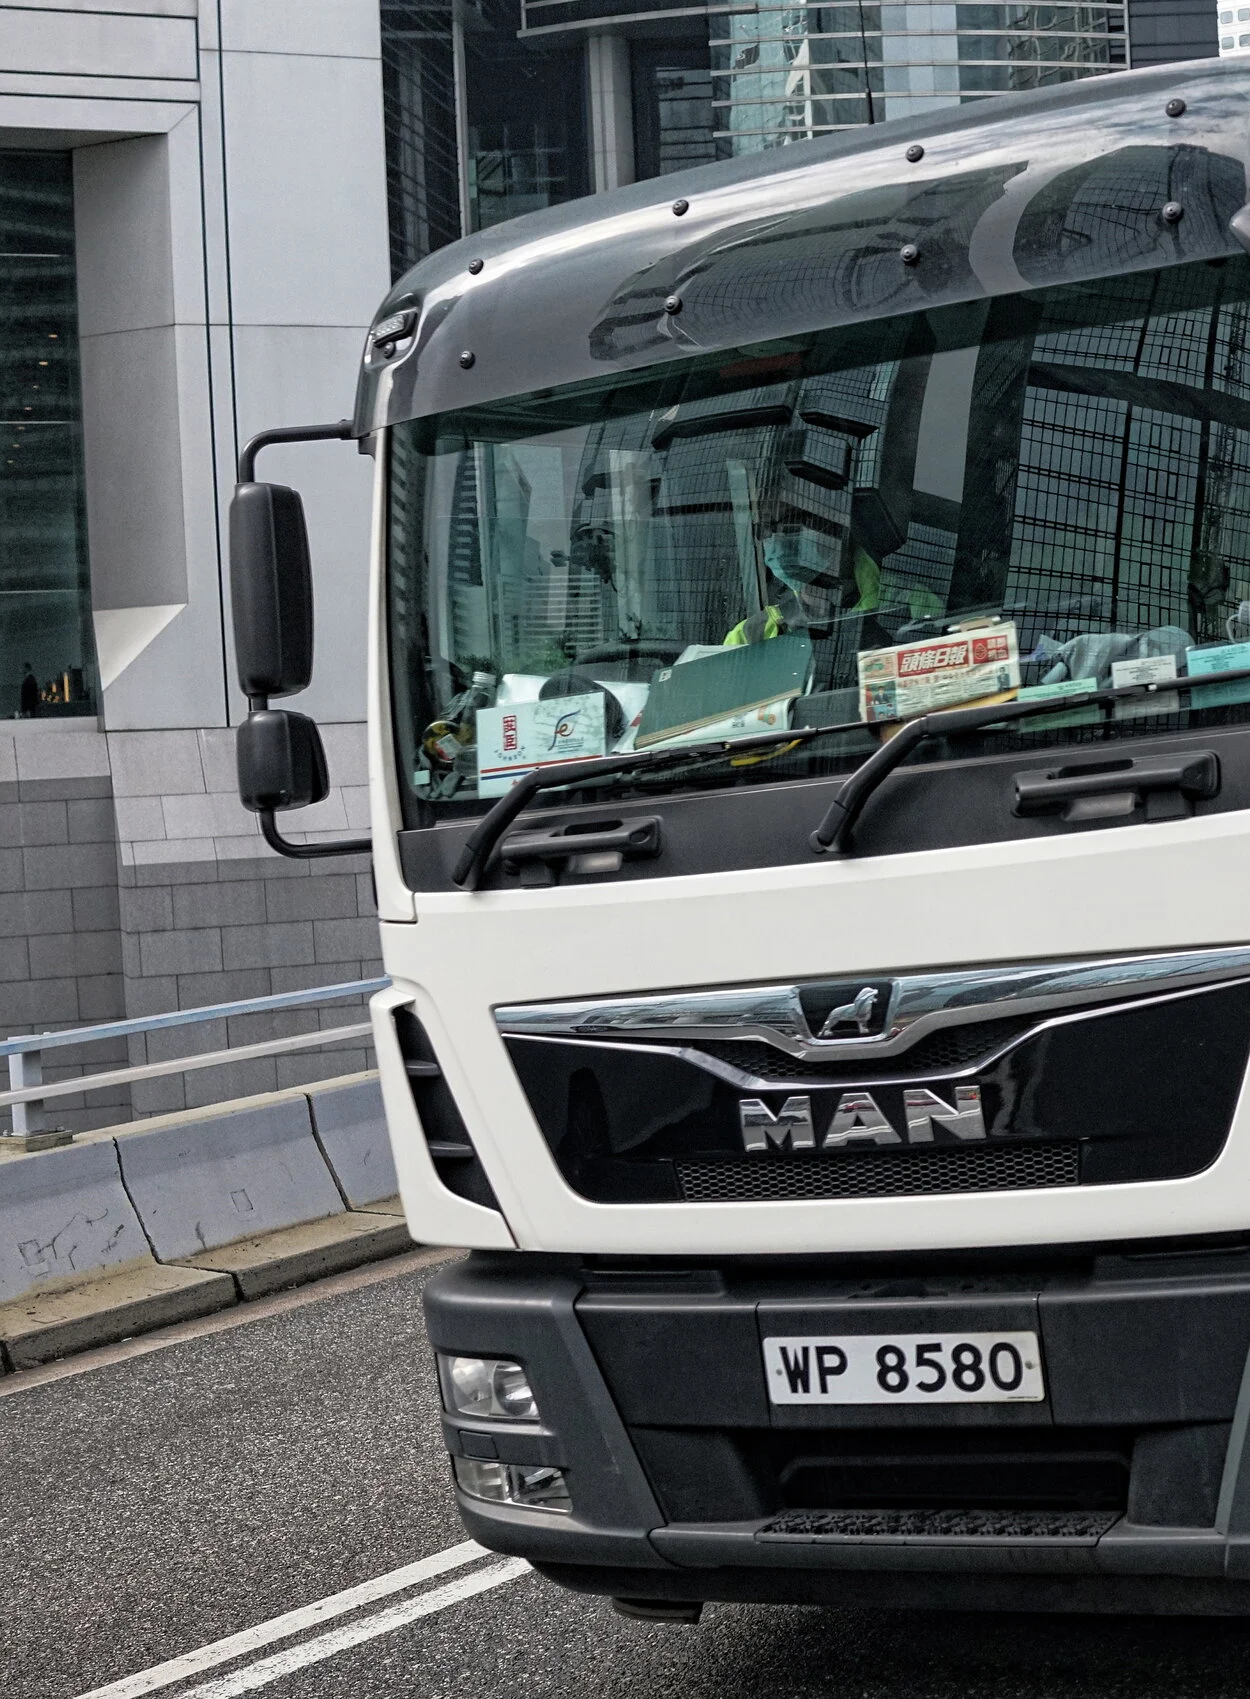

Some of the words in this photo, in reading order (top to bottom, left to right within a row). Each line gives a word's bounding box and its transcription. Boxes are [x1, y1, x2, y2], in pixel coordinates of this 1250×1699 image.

[901, 644, 968, 673] 頭條日報
[739, 1085, 987, 1152] MAN
[778, 1345, 849, 1395] WP
[875, 1341, 1024, 1394] 8580
